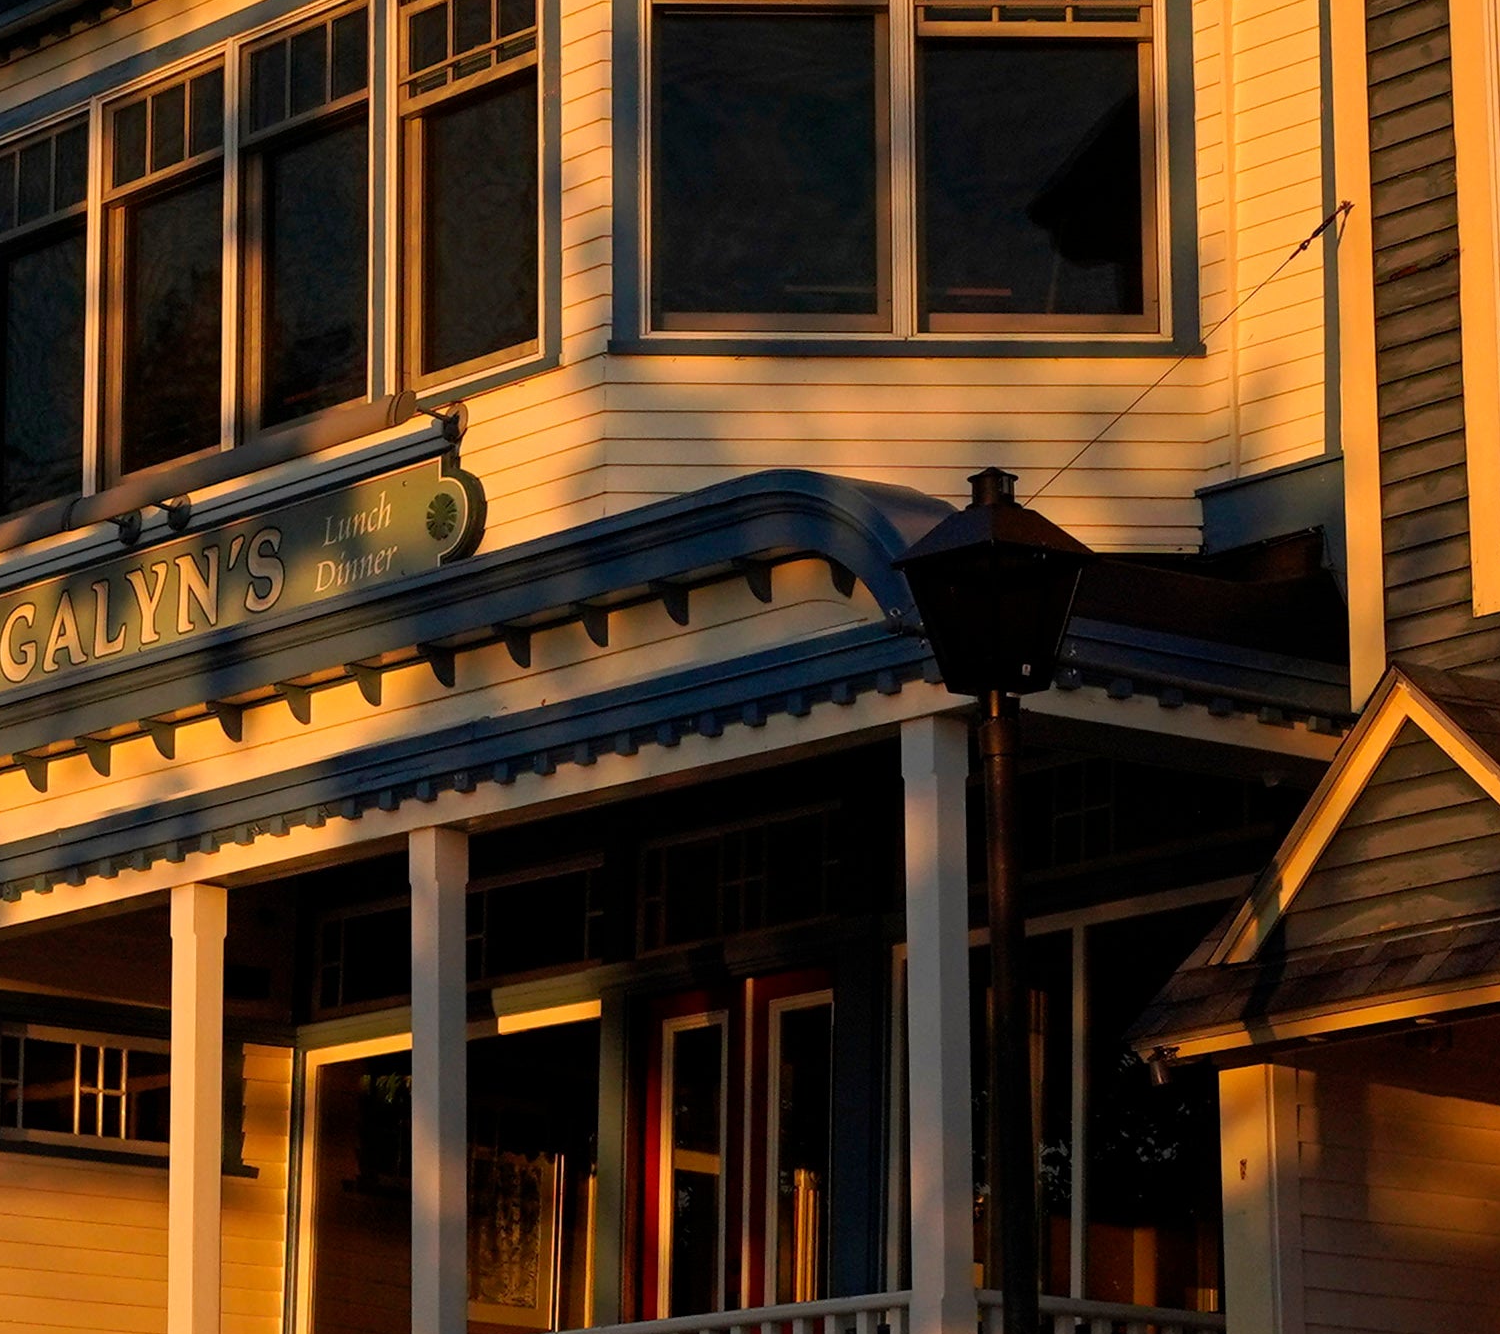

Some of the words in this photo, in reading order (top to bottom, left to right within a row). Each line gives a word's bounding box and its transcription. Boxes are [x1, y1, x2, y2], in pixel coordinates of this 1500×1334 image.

[321, 492, 392, 548] Lunch
[313, 541, 399, 595] Dinner
[0, 525, 288, 683] GALYN'S
